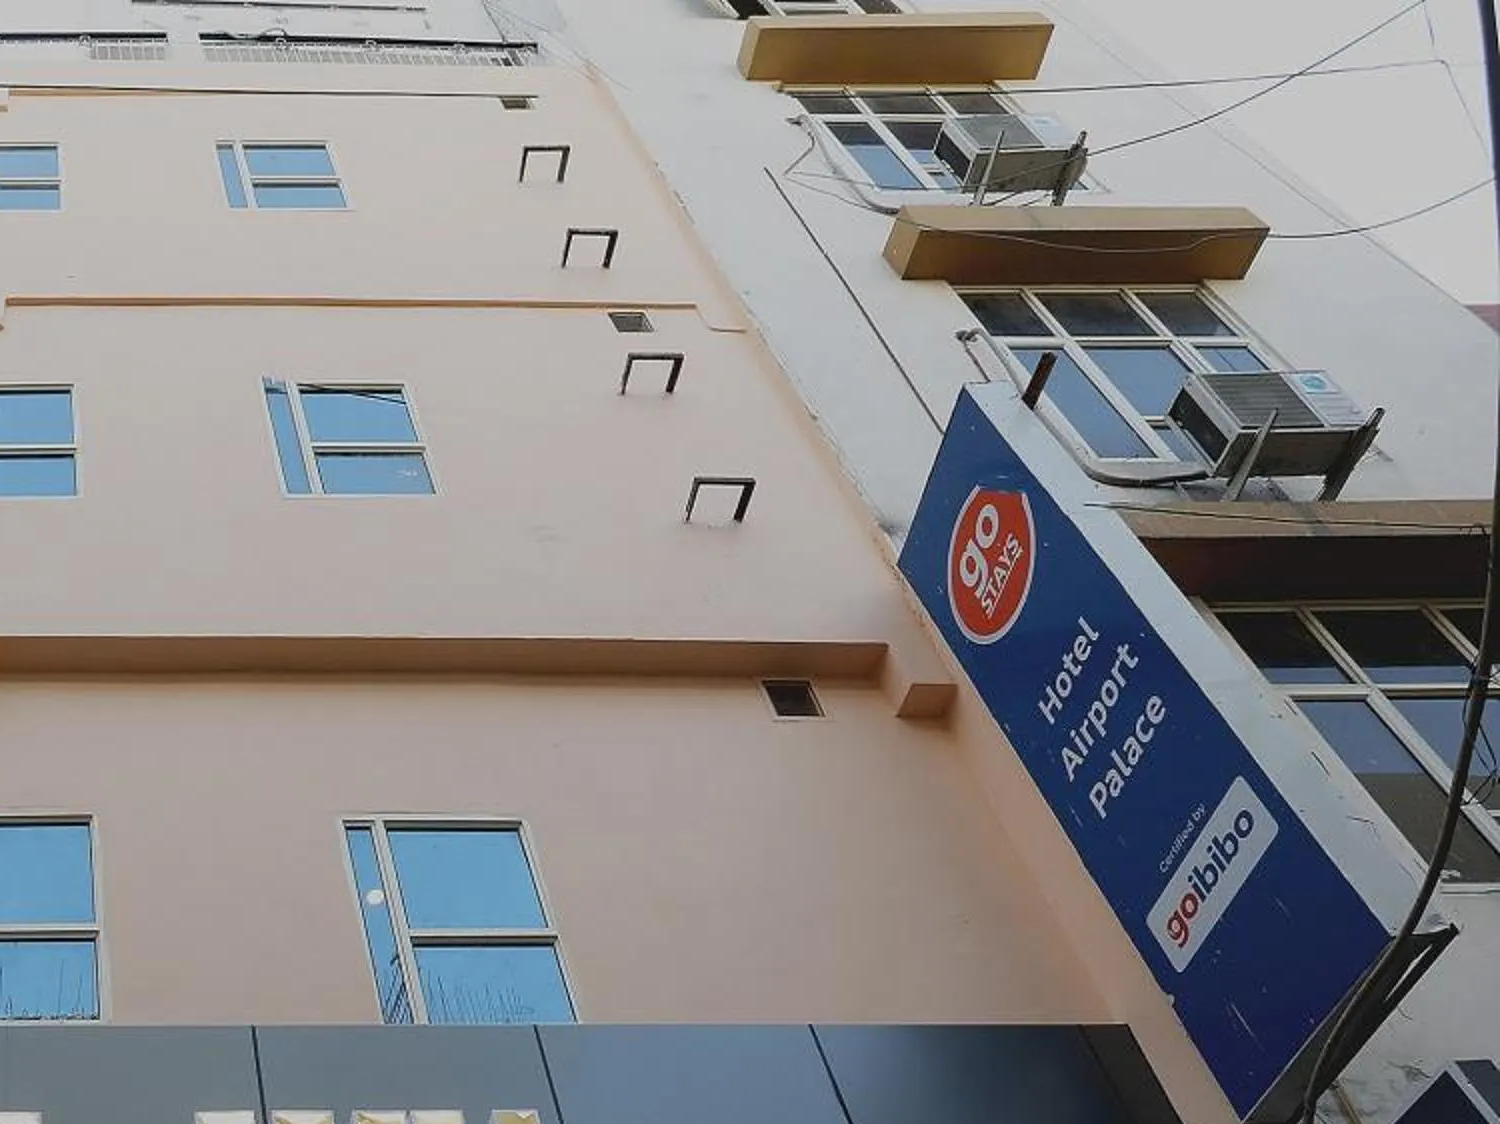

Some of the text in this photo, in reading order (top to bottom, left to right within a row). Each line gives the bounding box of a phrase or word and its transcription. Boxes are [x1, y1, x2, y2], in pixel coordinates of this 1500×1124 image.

[959, 503, 999, 599] go
[981, 532, 1024, 619] STAYS
[1038, 616, 1100, 725] Hotel
[1061, 643, 1140, 782] Airport
[1089, 695, 1166, 819] Palace
[1167, 809, 1255, 949] goibibo
